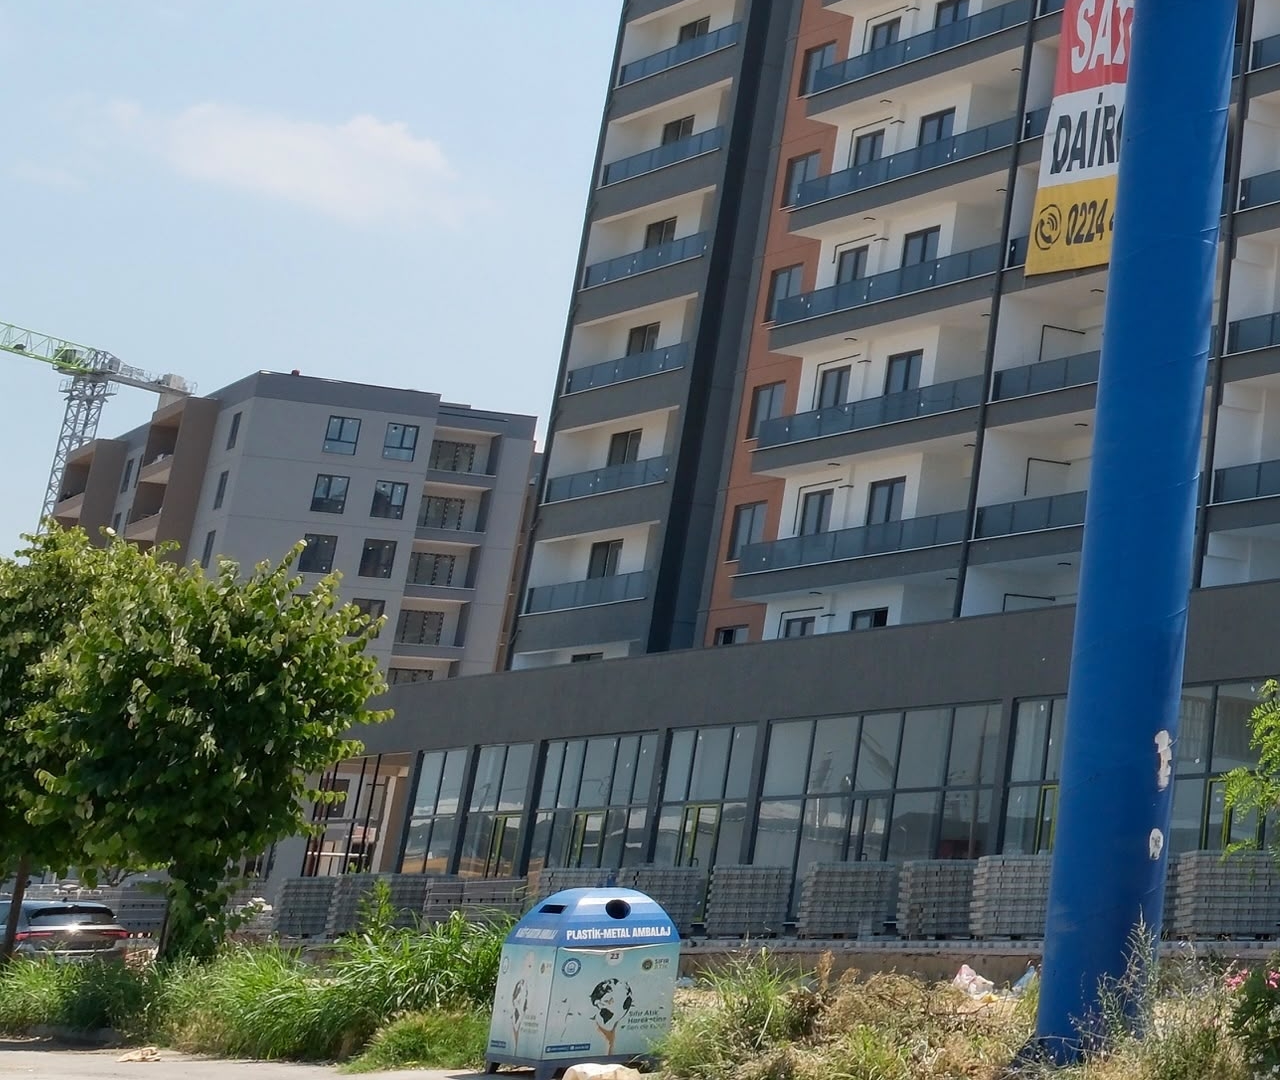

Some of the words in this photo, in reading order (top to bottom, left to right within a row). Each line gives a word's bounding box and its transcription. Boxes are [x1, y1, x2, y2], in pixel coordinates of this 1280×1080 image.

[1065, 198, 1108, 246] 0224
[566, 927, 630, 940] PLASTİK-METAL
[632, 926, 671, 937] AMBALAJ
